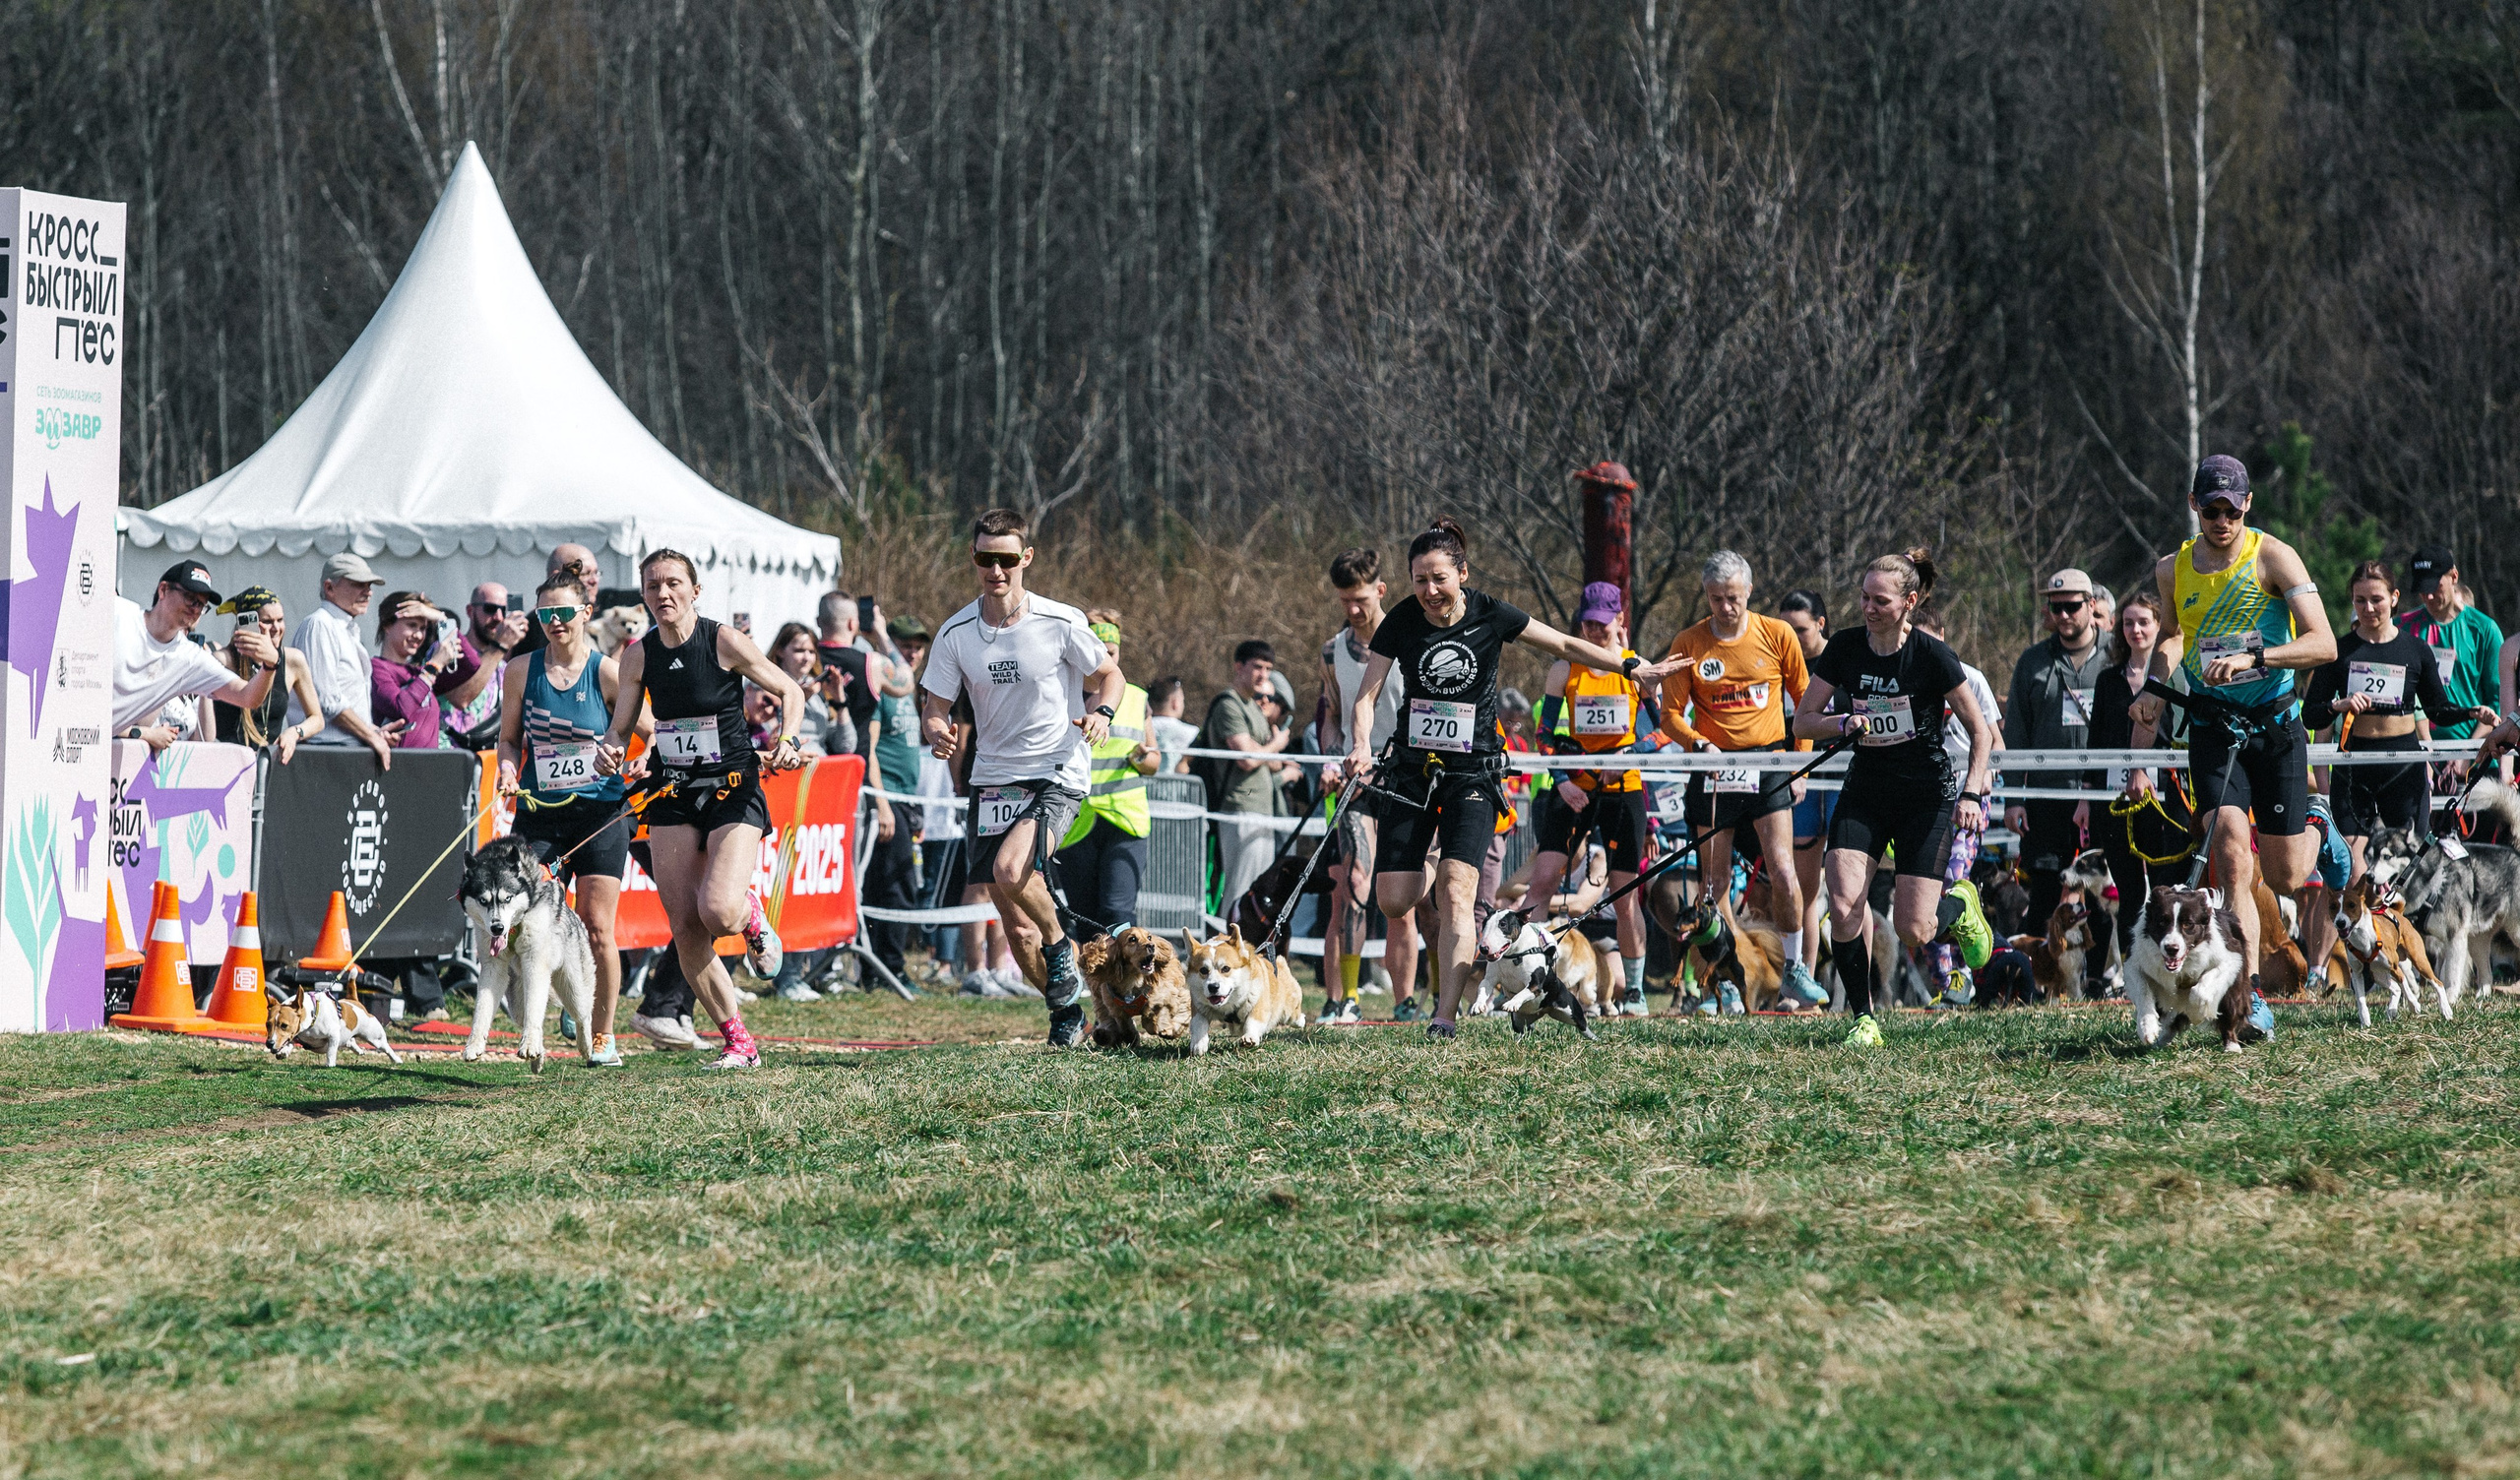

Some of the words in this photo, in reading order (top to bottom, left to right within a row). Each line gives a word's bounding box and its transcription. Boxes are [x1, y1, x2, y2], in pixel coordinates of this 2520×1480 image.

[36, 385, 51, 399] СЕТЬ
[989, 660, 1017, 671] TEAM
[1703, 661, 1722, 677] SM
[1859, 674, 1900, 693] FILA
[2364, 677, 2386, 694] 29
[1586, 709, 1614, 724] 251
[1421, 717, 1458, 739] 270
[674, 735, 698, 754] 14
[548, 759, 585, 778] 248
[792, 823, 846, 895] 2025
